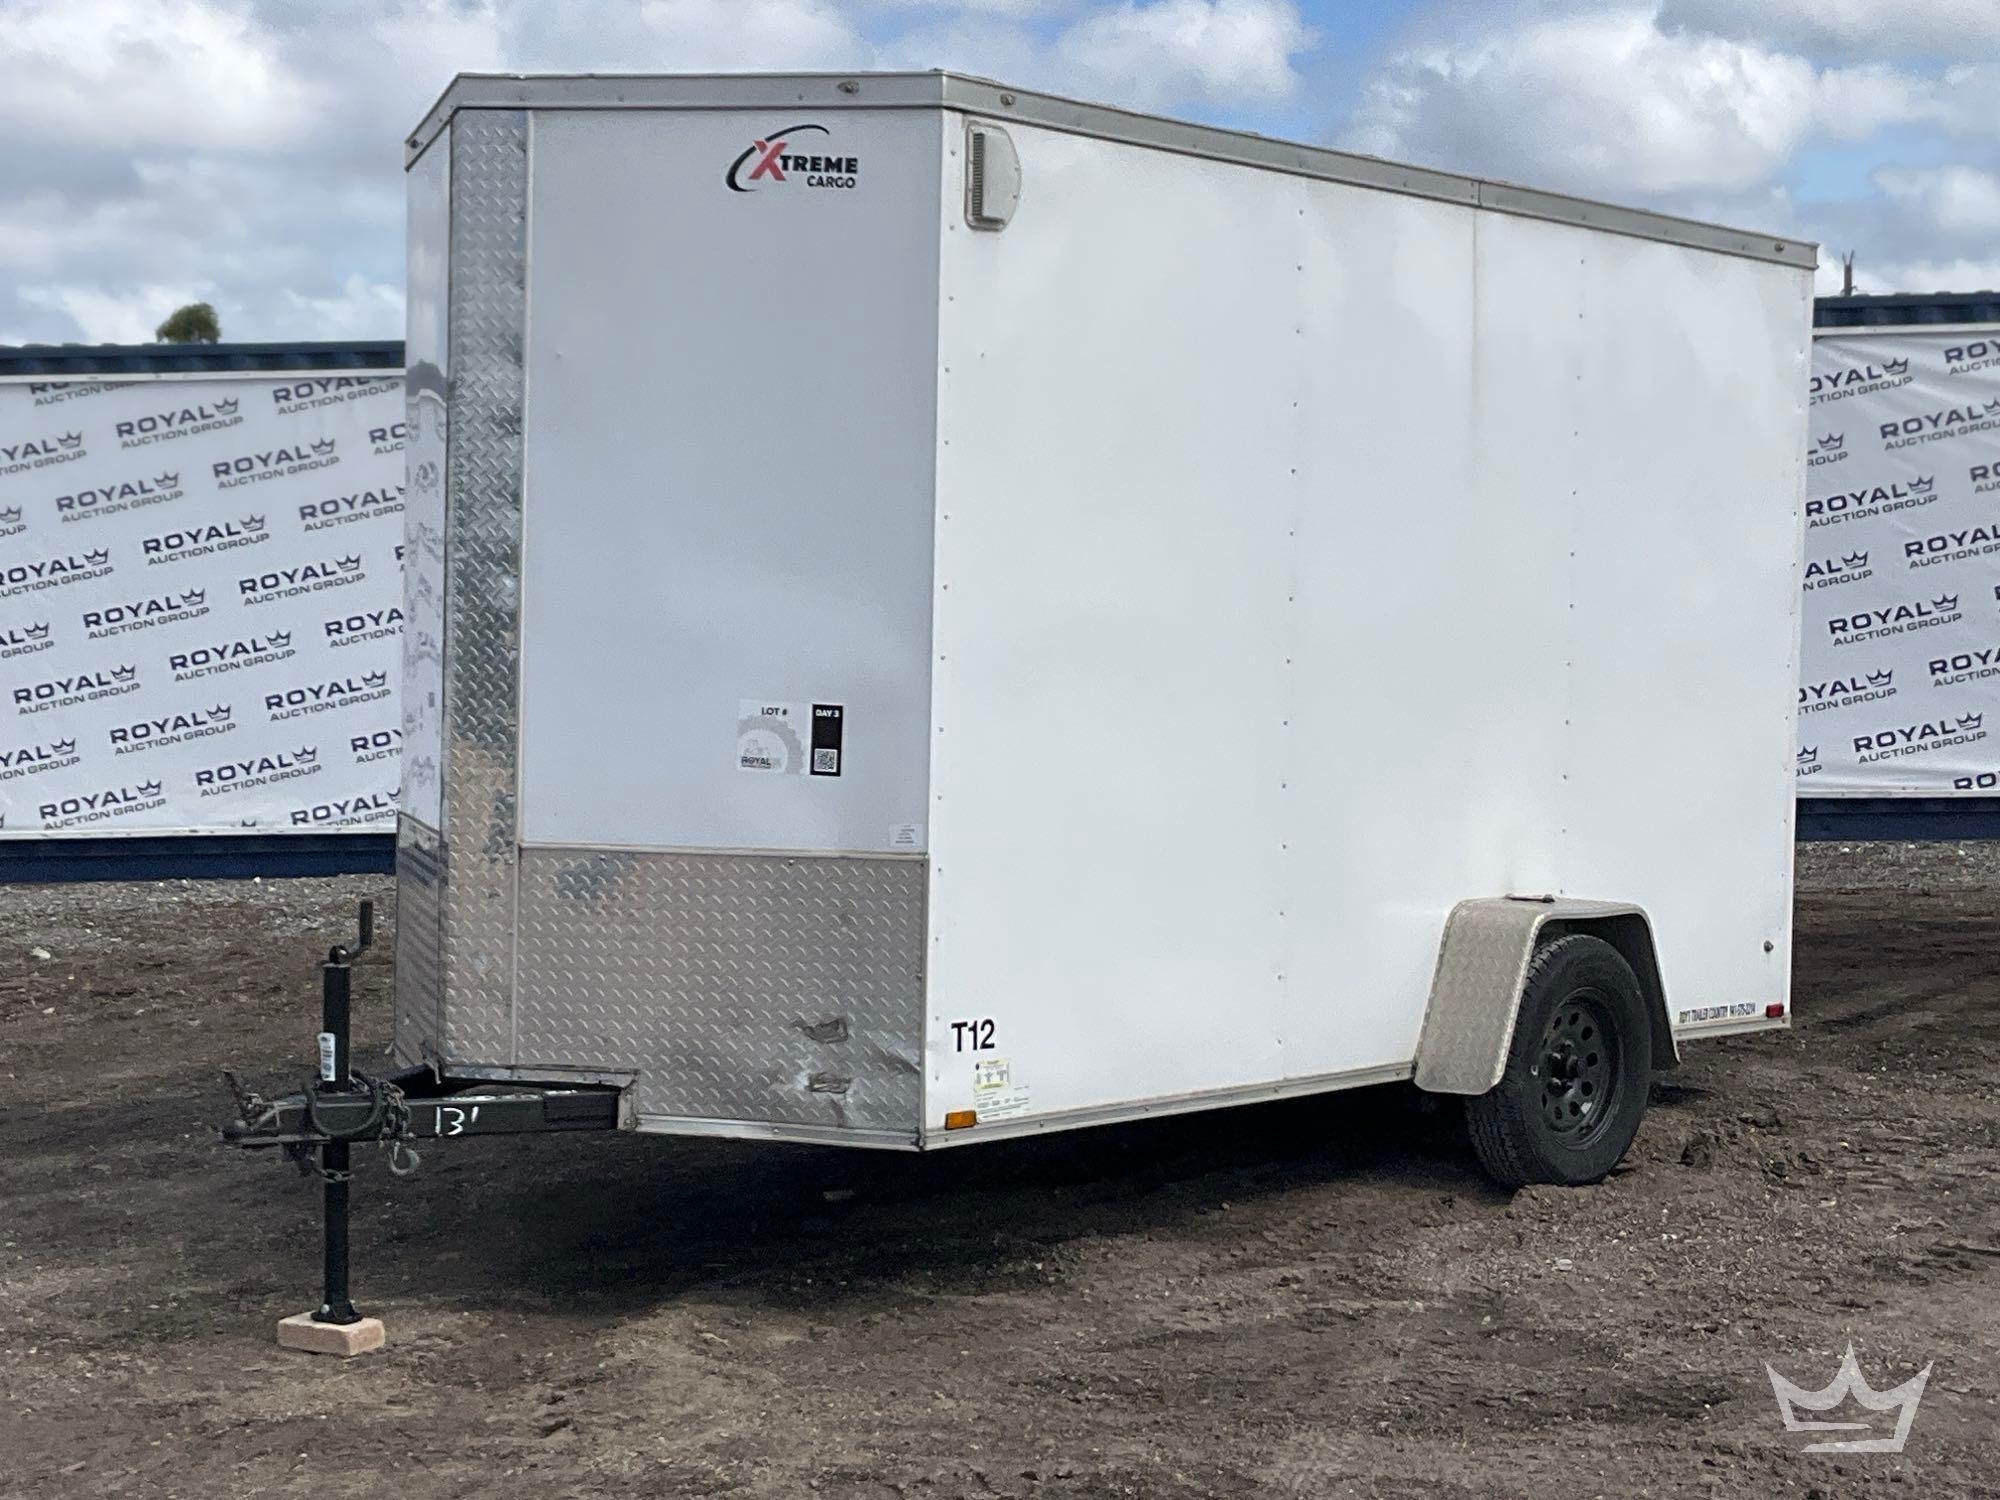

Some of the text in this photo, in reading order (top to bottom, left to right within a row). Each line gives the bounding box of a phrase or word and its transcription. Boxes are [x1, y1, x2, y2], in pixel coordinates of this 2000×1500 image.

[748, 140, 858, 182] XTREME
[807, 176, 856, 188] CARGO
[1944, 340, 2000, 364] ROY
[34, 384, 100, 406] AUCTION
[1810, 366, 1882, 393] OYAL
[1810, 376, 1913, 406] CTION GROUP
[278, 382, 399, 415] AUCTION GROUP
[116, 407, 214, 438] ROYAL
[121, 417, 243, 449] AUCTION GROUP
[1880, 406, 1983, 439] ROYAL
[1884, 419, 2000, 451] AUCTION GROU
[0, 450, 87, 476] TION GROUP
[1, 440, 58, 461] YAL
[213, 446, 312, 478] ROYAL
[1808, 451, 1848, 467] ROUP
[218, 456, 340, 489] AUCTION GROUP
[56, 481, 155, 512] ROYAL
[61, 491, 183, 524] AUCTION GROUP
[299, 488, 396, 520] ROYAL
[1805, 484, 1908, 517] ROYAL
[1810, 495, 1938, 528] AUCTION GROUP
[0, 524, 26, 537] OUP
[304, 503, 405, 532] AUCTION GRO
[143, 522, 241, 554] ROYAL
[148, 533, 270, 565] AUCTION GROUP
[0, 556, 84, 586] OYAL
[1909, 547, 1980, 569] AUCTION
[0, 566, 114, 598] UCTION GROUP
[240, 563, 338, 595] ROYAL
[245, 573, 367, 606] AUCTION GROUP
[1818, 569, 1872, 588] GROUP
[83, 597, 181, 628] ROYAL
[88, 607, 210, 639] AUCTION GROUP
[325, 608, 403, 637] ROYA
[1828, 602, 1932, 634] ROYAL
[330, 627, 396, 648] AUCTION
[1833, 613, 1962, 647] AUCTION GROUP
[2, 640, 54, 658] GROUP
[170, 639, 268, 670] ROYAL
[1929, 649, 2000, 676] ROY
[175, 649, 297, 682] AUCTION GROUP
[14, 672, 111, 704] ROYAL
[19, 682, 141, 715] AUCTION GROUP
[265, 678, 362, 710] ROYAL
[1802, 688, 1897, 715] TION GROUP
[270, 688, 392, 721] AUCTION GROUP
[762, 707, 780, 716] LOT
[110, 712, 208, 744] ROYAL
[115, 722, 237, 755] AUCTION GROUP
[1854, 720, 1956, 752] ROYAL
[0, 746, 52, 768] YAL
[355, 748, 403, 764] AUCTI
[1858, 731, 1987, 764] AUCTION GROUP
[28, 756, 80, 774] GROUP
[195, 753, 293, 785] ROYAL
[200, 764, 322, 796] AUCTION GROUP
[39, 788, 137, 819] ROYAL
[44, 798, 166, 830] AUCTION GROUP
[291, 794, 388, 825] ROYAL
[364, 809, 398, 822] GRO
[951, 1019, 995, 1052] T12
